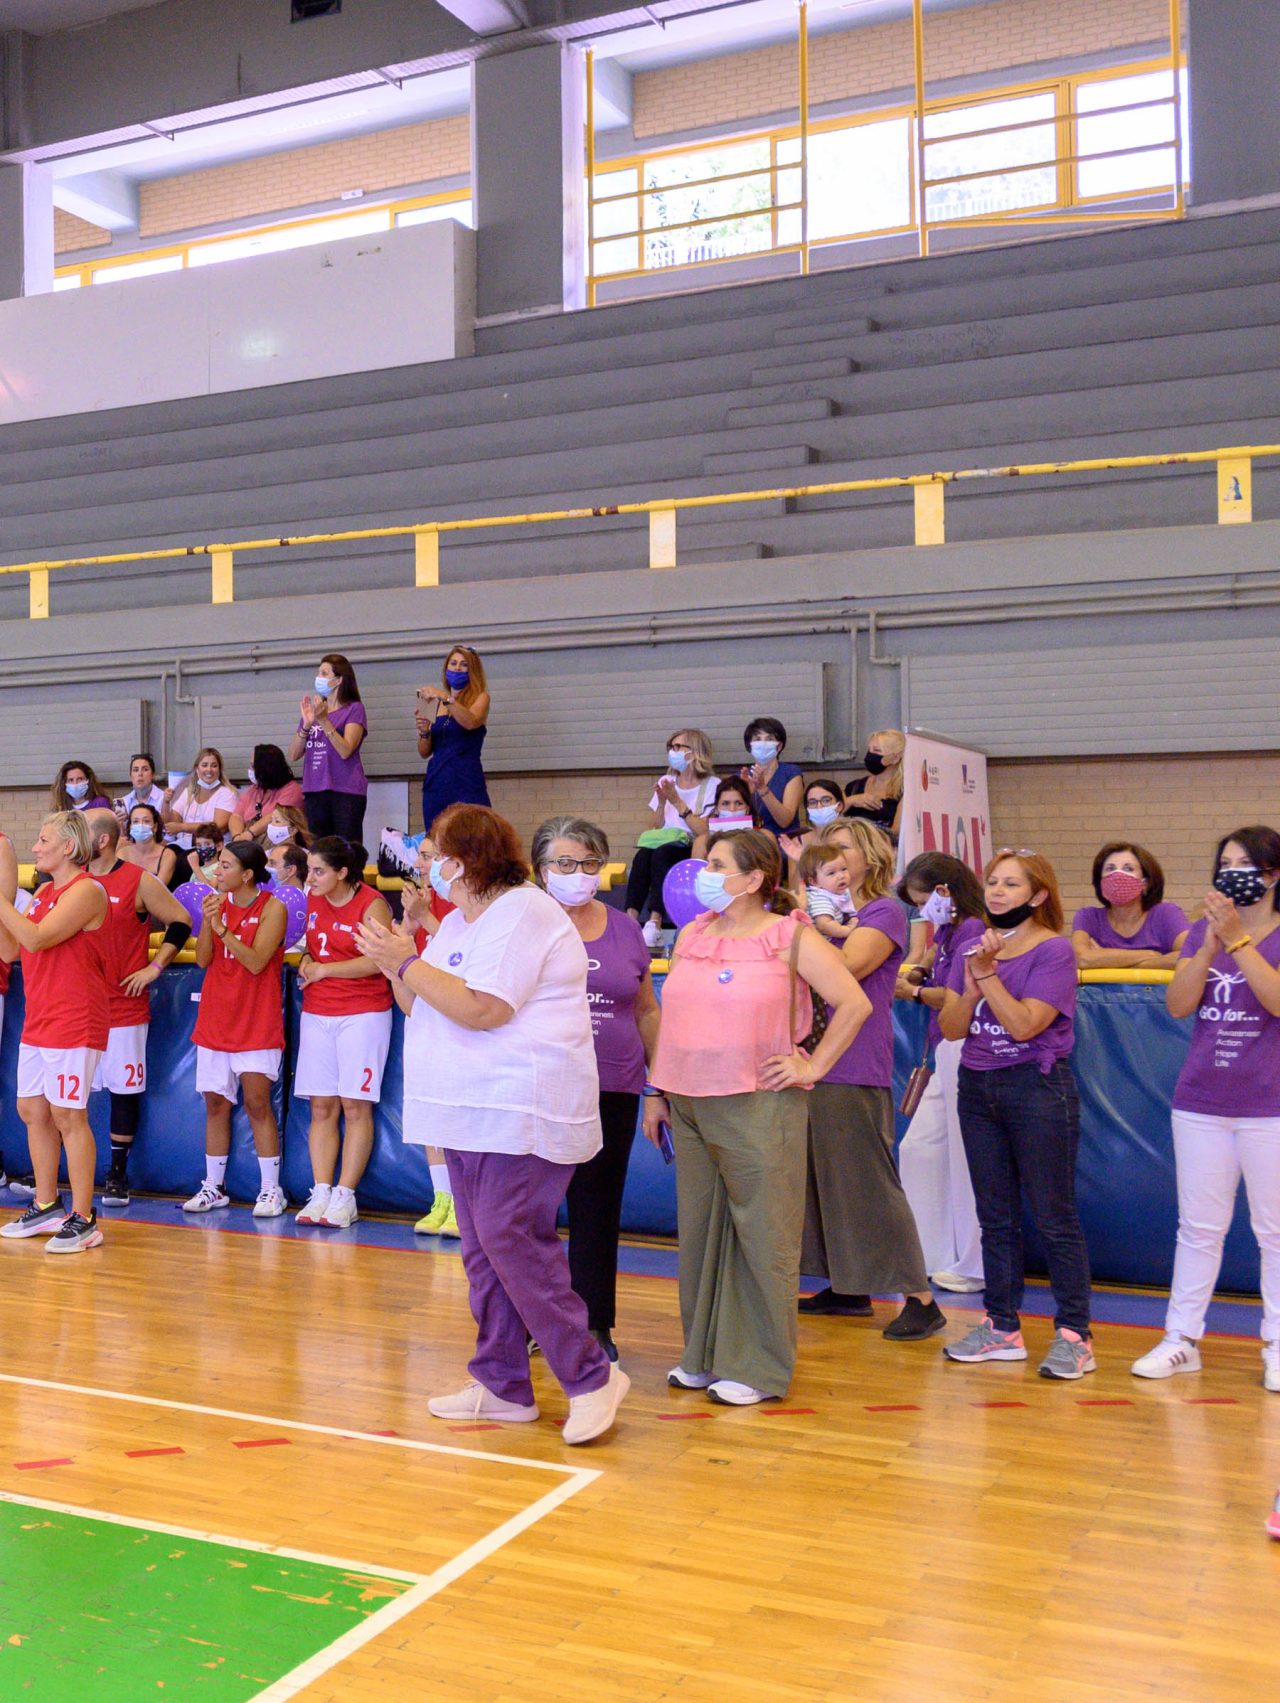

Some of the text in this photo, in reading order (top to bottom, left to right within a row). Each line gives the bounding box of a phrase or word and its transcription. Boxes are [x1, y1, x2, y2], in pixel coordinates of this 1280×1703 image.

[317, 932, 330, 956] 2
[56, 1073, 80, 1101] 12
[124, 1063, 144, 1087] 29
[360, 1067, 373, 1093] 2
